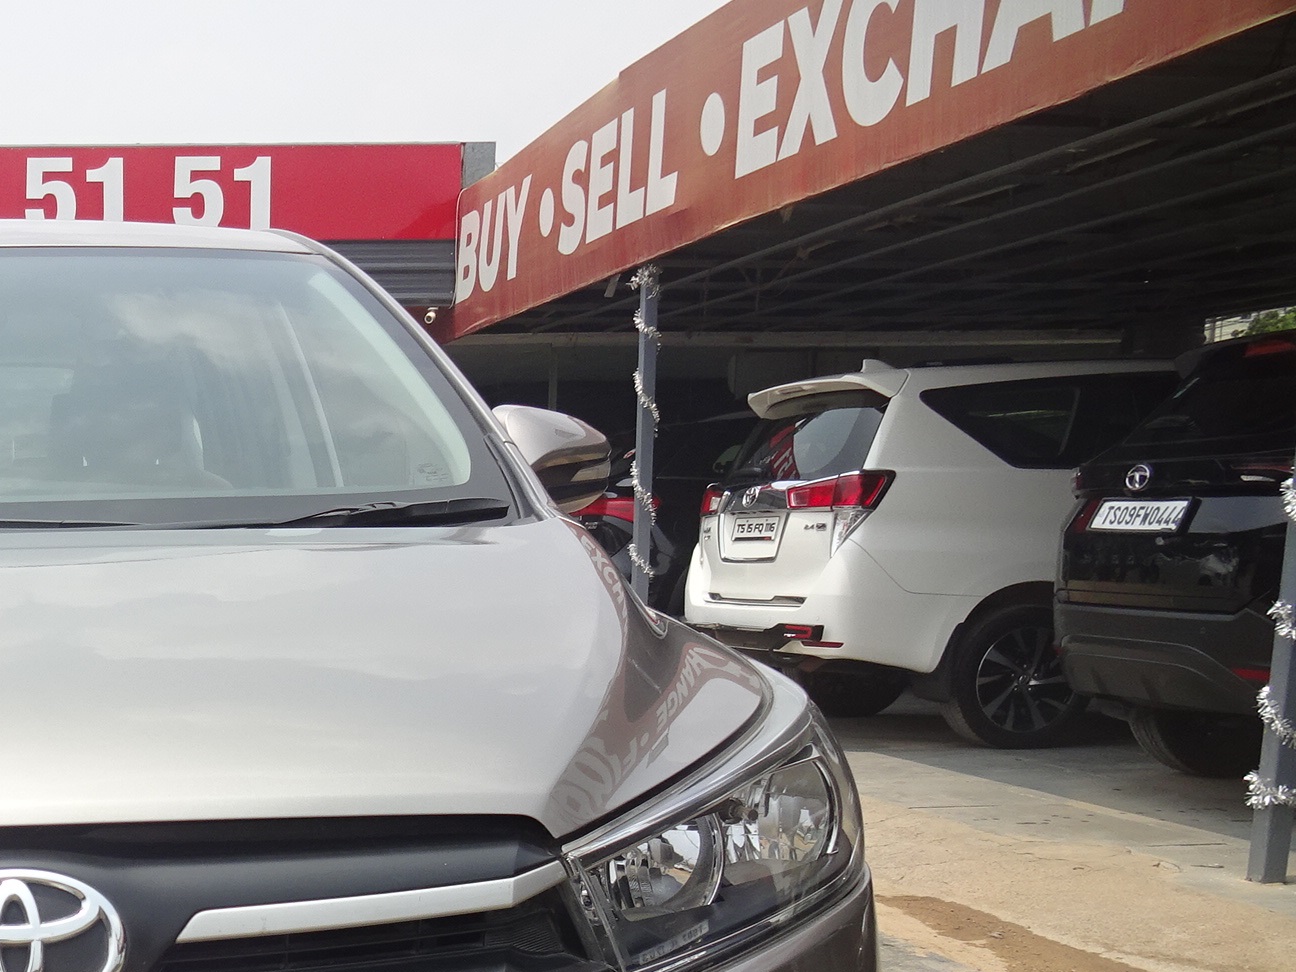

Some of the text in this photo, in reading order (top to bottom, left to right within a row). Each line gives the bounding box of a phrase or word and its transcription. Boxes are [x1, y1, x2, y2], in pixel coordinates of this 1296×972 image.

[455, 0, 1124, 304] BUY SELL EXCH
[24, 156, 124, 221] 51
[172, 155, 272, 230] 51
[1102, 506, 1186, 526] TS09FW0444
